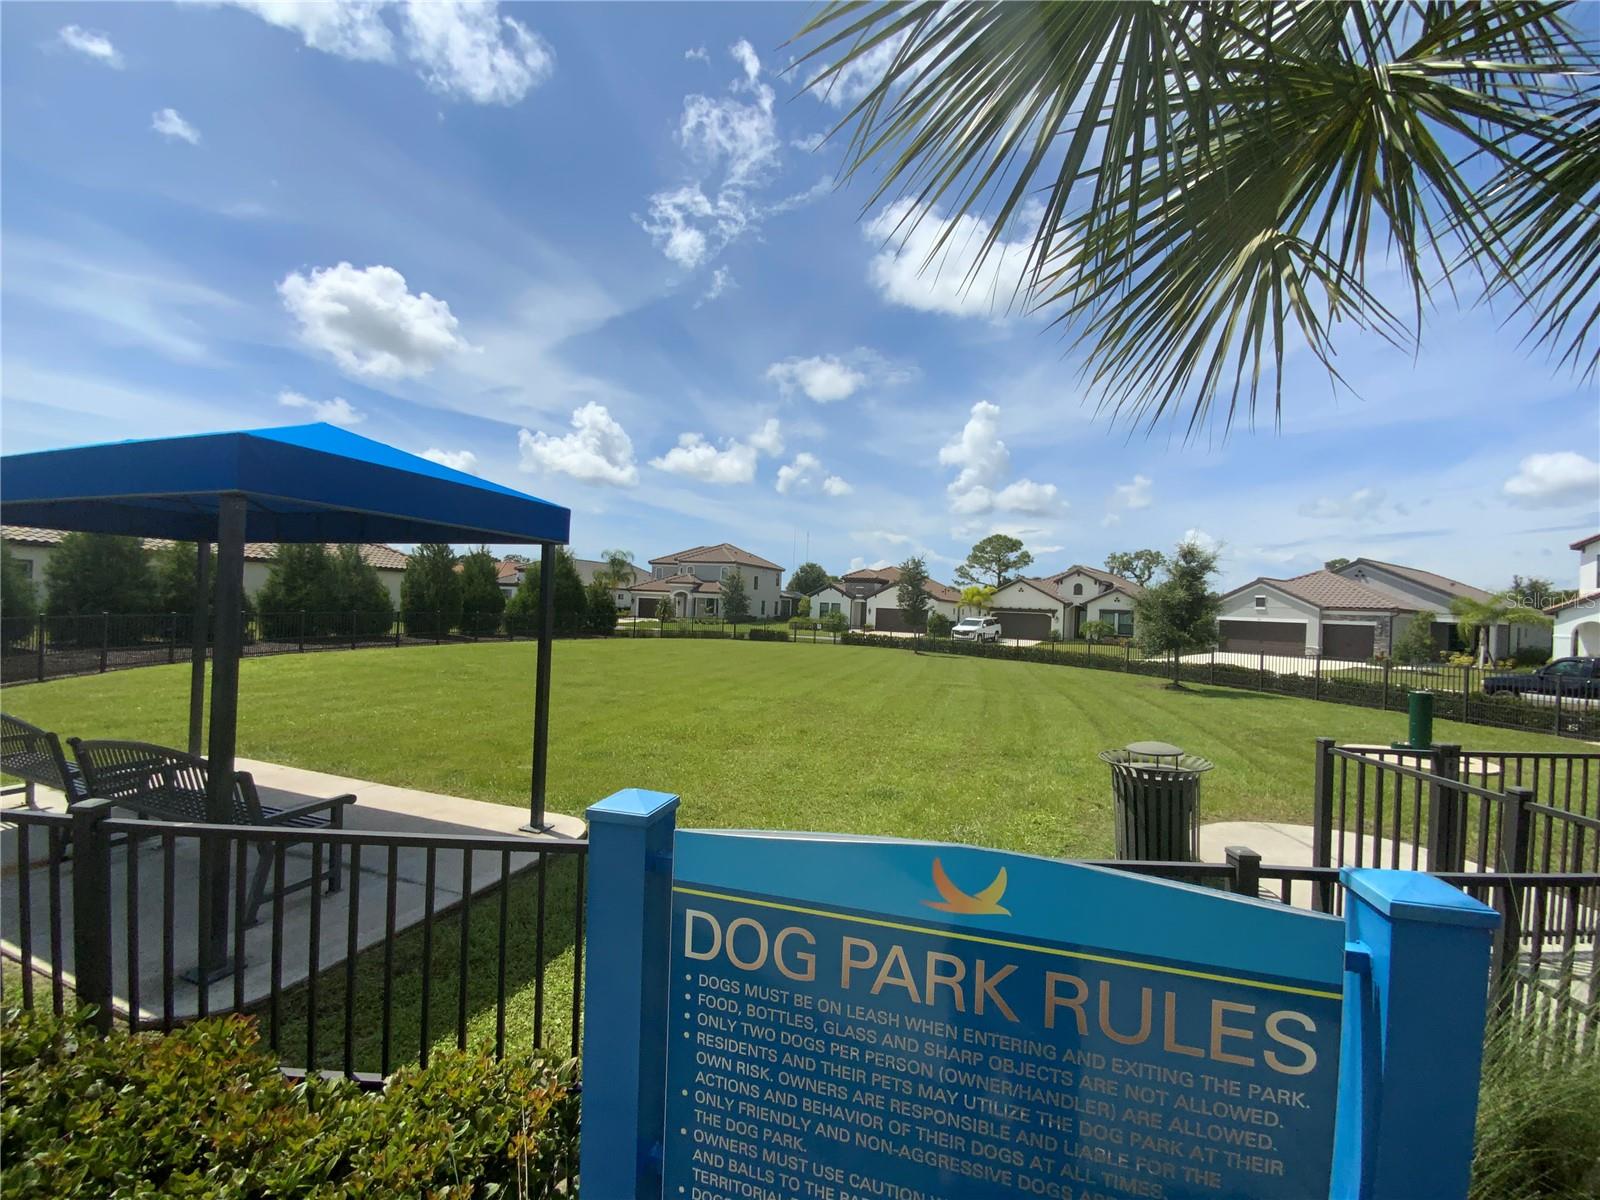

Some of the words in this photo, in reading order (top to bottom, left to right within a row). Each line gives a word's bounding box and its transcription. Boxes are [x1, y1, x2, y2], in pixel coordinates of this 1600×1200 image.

[684, 909, 816, 982] DOG
[841, 935, 1019, 1023] PARK
[1044, 970, 1318, 1076] RULES
[698, 974, 740, 994] DOGS
[744, 983, 789, 1005] MUST
[793, 993, 813, 1009] BE
[817, 998, 841, 1016] ON
[846, 1004, 900, 1028] LEASH
[904, 1015, 958, 1040] WHEN
[963, 1027, 1057, 1061] ENTERING
[1062, 1049, 1106, 1070] AND
[1111, 1058, 1194, 1088] EXITING
[1200, 1074, 1241, 1097] THE
[1247, 1083, 1311, 1109] PARK.
[696, 1051, 732, 1071] OWN
[736, 1061, 774, 1082] RISK.
[778, 1071, 848, 1100] OWNERS
[852, 1089, 885, 1110] ARE
[890, 1098, 1011, 1141] RESPONSIBLE
[1016, 1129, 1058, 1152] AND
[1063, 1140, 1129, 1169] LIABLE
[1135, 1156, 1176, 1180] FOR
[1182, 1165, 1222, 1189] THE
[697, 1012, 737, 1032] ONLY
[741, 1022, 776, 1042] TWO
[781, 1031, 825, 1053] DOGS
[830, 1042, 860, 1062] PER
[864, 1050, 934, 1078] PERSON
[938, 1065, 1117, 1121] (OWNER/HANDLER)
[1121, 1107, 1163, 1130] ARE
[1168, 1117, 1278, 1151] ALLOWED.
[697, 1031, 778, 1063] RESIDENTS
[782, 1052, 817, 1071] AND
[820, 1060, 866, 1084] THEIR
[871, 1073, 913, 1095] PETS
[918, 1083, 959, 1105] MAY
[964, 1093, 1031, 1124] UTILIZE
[1035, 1110, 1073, 1133] THE
[1079, 1119, 1123, 1144] DOG
[1129, 1131, 1184, 1158] PARK
[1189, 1144, 1219, 1165] AT
[1223, 1150, 1285, 1177] THEIR
[698, 993, 742, 1016] FOOD,
[746, 1003, 818, 1033] BOTTLES,
[823, 1020, 877, 1044] GLASS
[882, 1033, 919, 1052] AND
[924, 1041, 984, 1067] SHARP
[988, 1055, 1073, 1087] OBJECTS
[1078, 1075, 1118, 1096] ARE
[1124, 1083, 1169, 1107] NOT
[1173, 1094, 1284, 1129] ALLOWED.
[692, 1149, 724, 1168] AND
[728, 1159, 775, 1184] BALLS
[778, 1173, 800, 1192] TO
[804, 1180, 835, 1200] THE
[693, 1108, 721, 1129] THE
[725, 1118, 759, 1139] DOG
[763, 1128, 807, 1153] PARK.
[693, 1129, 758, 1158] OWNERS
[762, 1149, 808, 1173] MUST
[812, 1162, 845, 1184] USE
[694, 1090, 735, 1111] ONLY
[738, 1101, 811, 1132] FRIENDLY
[814, 1122, 850, 1143] AND
[855, 1132, 1012, 1187] NON-AGGRESSIVE
[1018, 1174, 1073, 1200] DOGS
[695, 1071, 760, 1098] ACTIONS
[764, 1088, 798, 1108] AND
[802, 1097, 883, 1131] BEHAVIOR
[888, 1119, 912, 1136] OF
[915, 1125, 966, 1152] THEIR
[971, 1140, 1025, 1167] DOGS
[1029, 1154, 1056, 1174] AT
[1059, 1162, 1096, 1185] ALL
[691, 1187, 732, 1200] DOG
